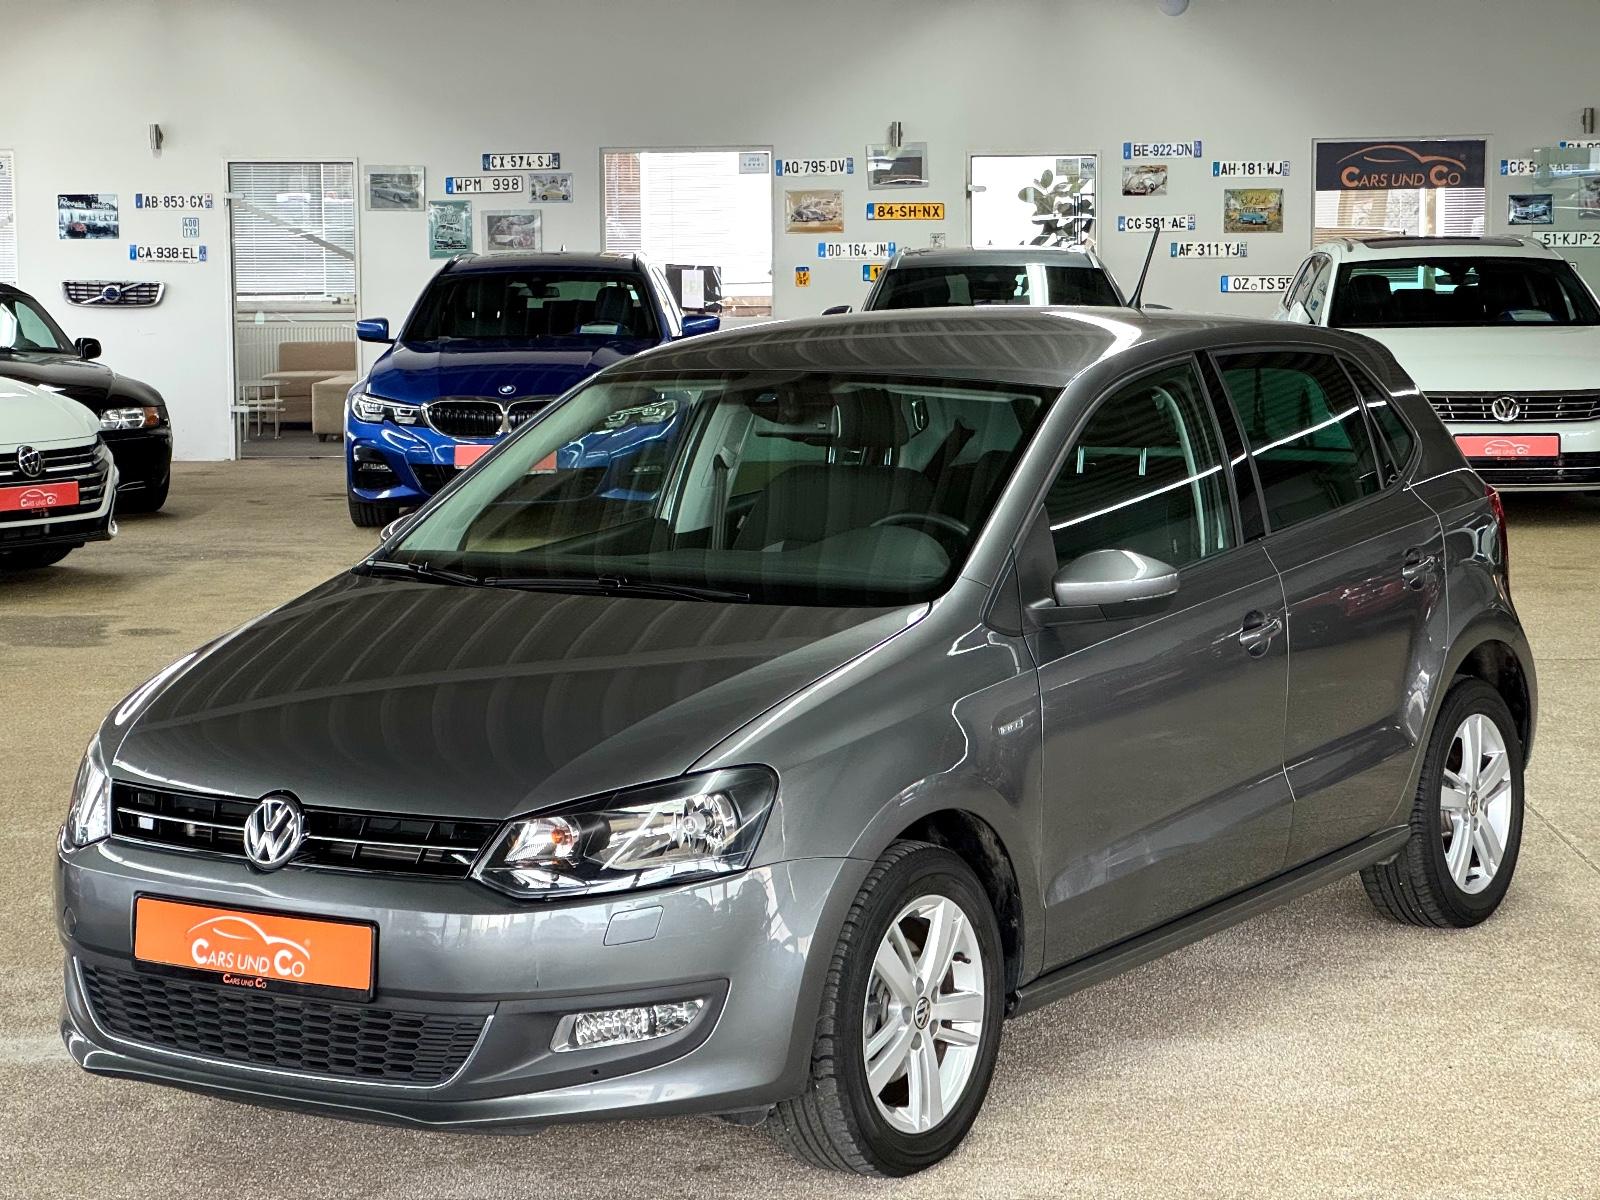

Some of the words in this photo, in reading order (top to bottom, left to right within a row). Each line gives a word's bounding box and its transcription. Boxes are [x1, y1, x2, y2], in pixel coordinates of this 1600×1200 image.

[1133, 143, 1193, 157] BE-922-DN
[491, 155, 552, 168] CX-574-SJ
[784, 160, 846, 174] AQ-795-DV
[1220, 162, 1283, 175] AH-181-WJ
[1340, 166, 1388, 188] CARS
[1391, 173, 1425, 187] UND
[1429, 164, 1461, 187] CO
[455, 179, 482, 192] WPM
[492, 178, 519, 191] 998
[144, 195, 204, 208] AB-853-GX
[877, 206, 941, 218] 84-SH-NX
[1126, 217, 1187, 230] CG-581-AE
[137, 246, 198, 259] CA-938-EL
[1178, 243, 1240, 256] AF-311-YJ
[1233, 278, 1250, 290] OZ
[1258, 278, 1275, 290] TS
[191, 938, 234, 968] CARS
[236, 954, 270, 974] UND
[274, 949, 305, 978] CO
[222, 973, 240, 986] CARS
[255, 977, 267, 989] CO
